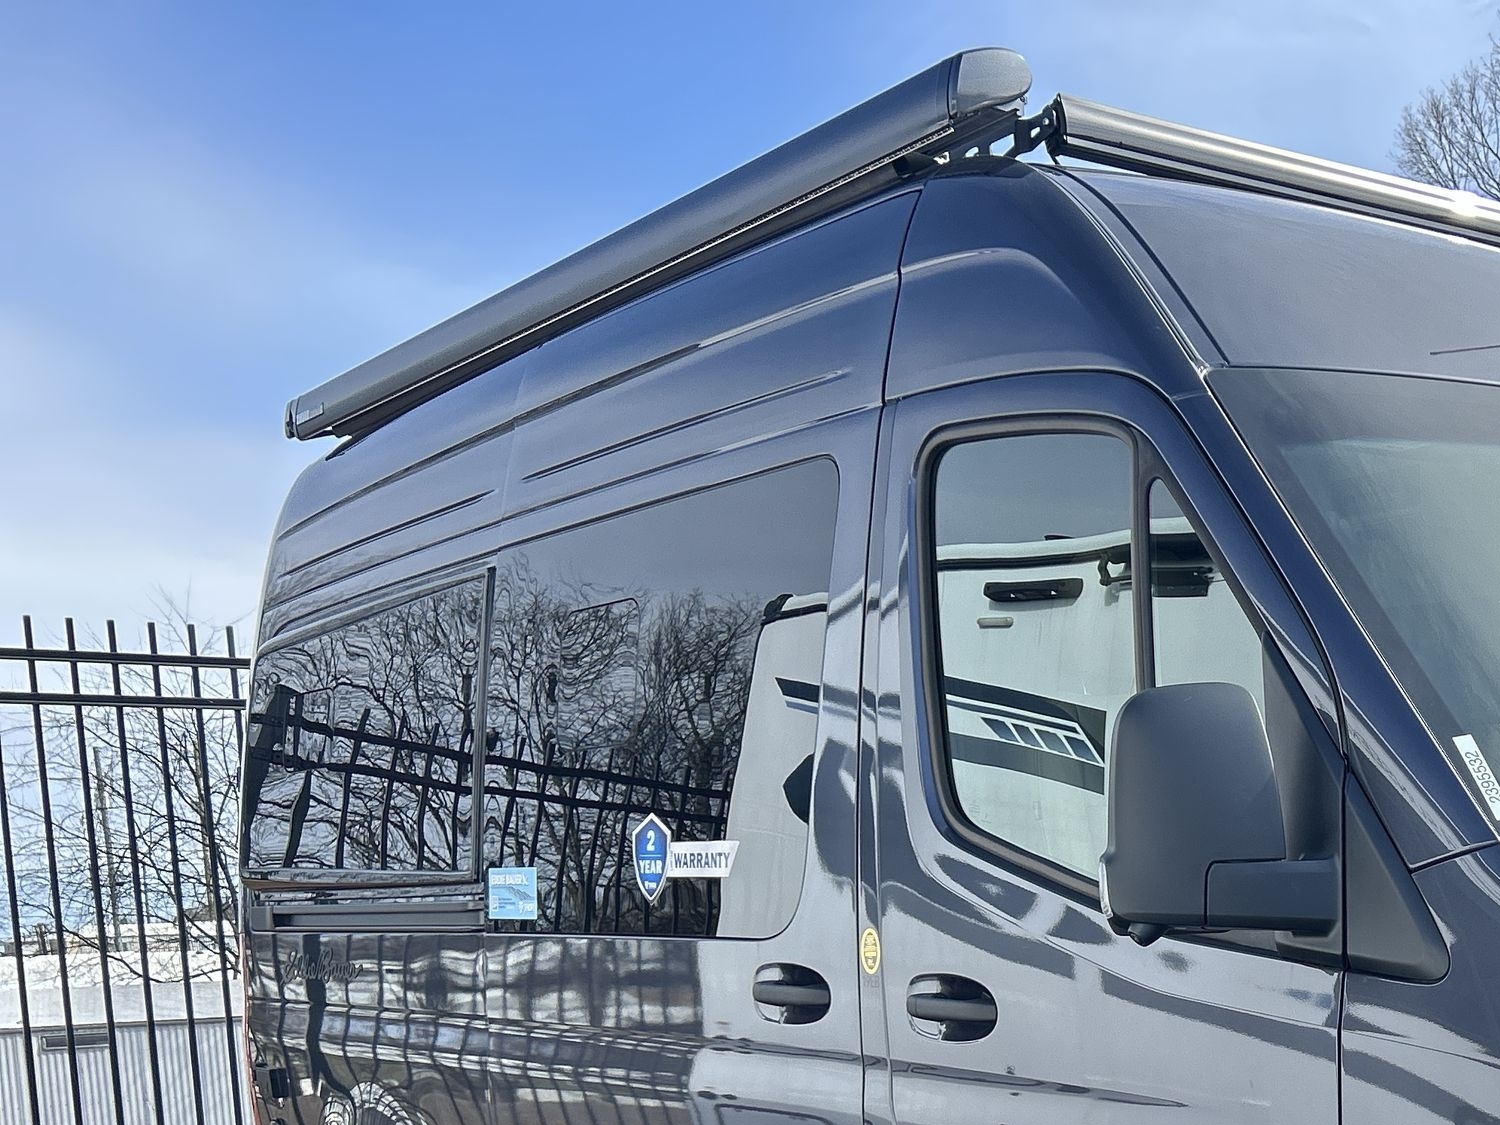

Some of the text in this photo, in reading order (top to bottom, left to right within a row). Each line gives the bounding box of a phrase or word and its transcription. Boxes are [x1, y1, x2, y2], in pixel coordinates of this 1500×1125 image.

[646, 829, 656, 852] 2
[639, 859, 663, 874] YEAR
[673, 851, 731, 869] WARRANTY
